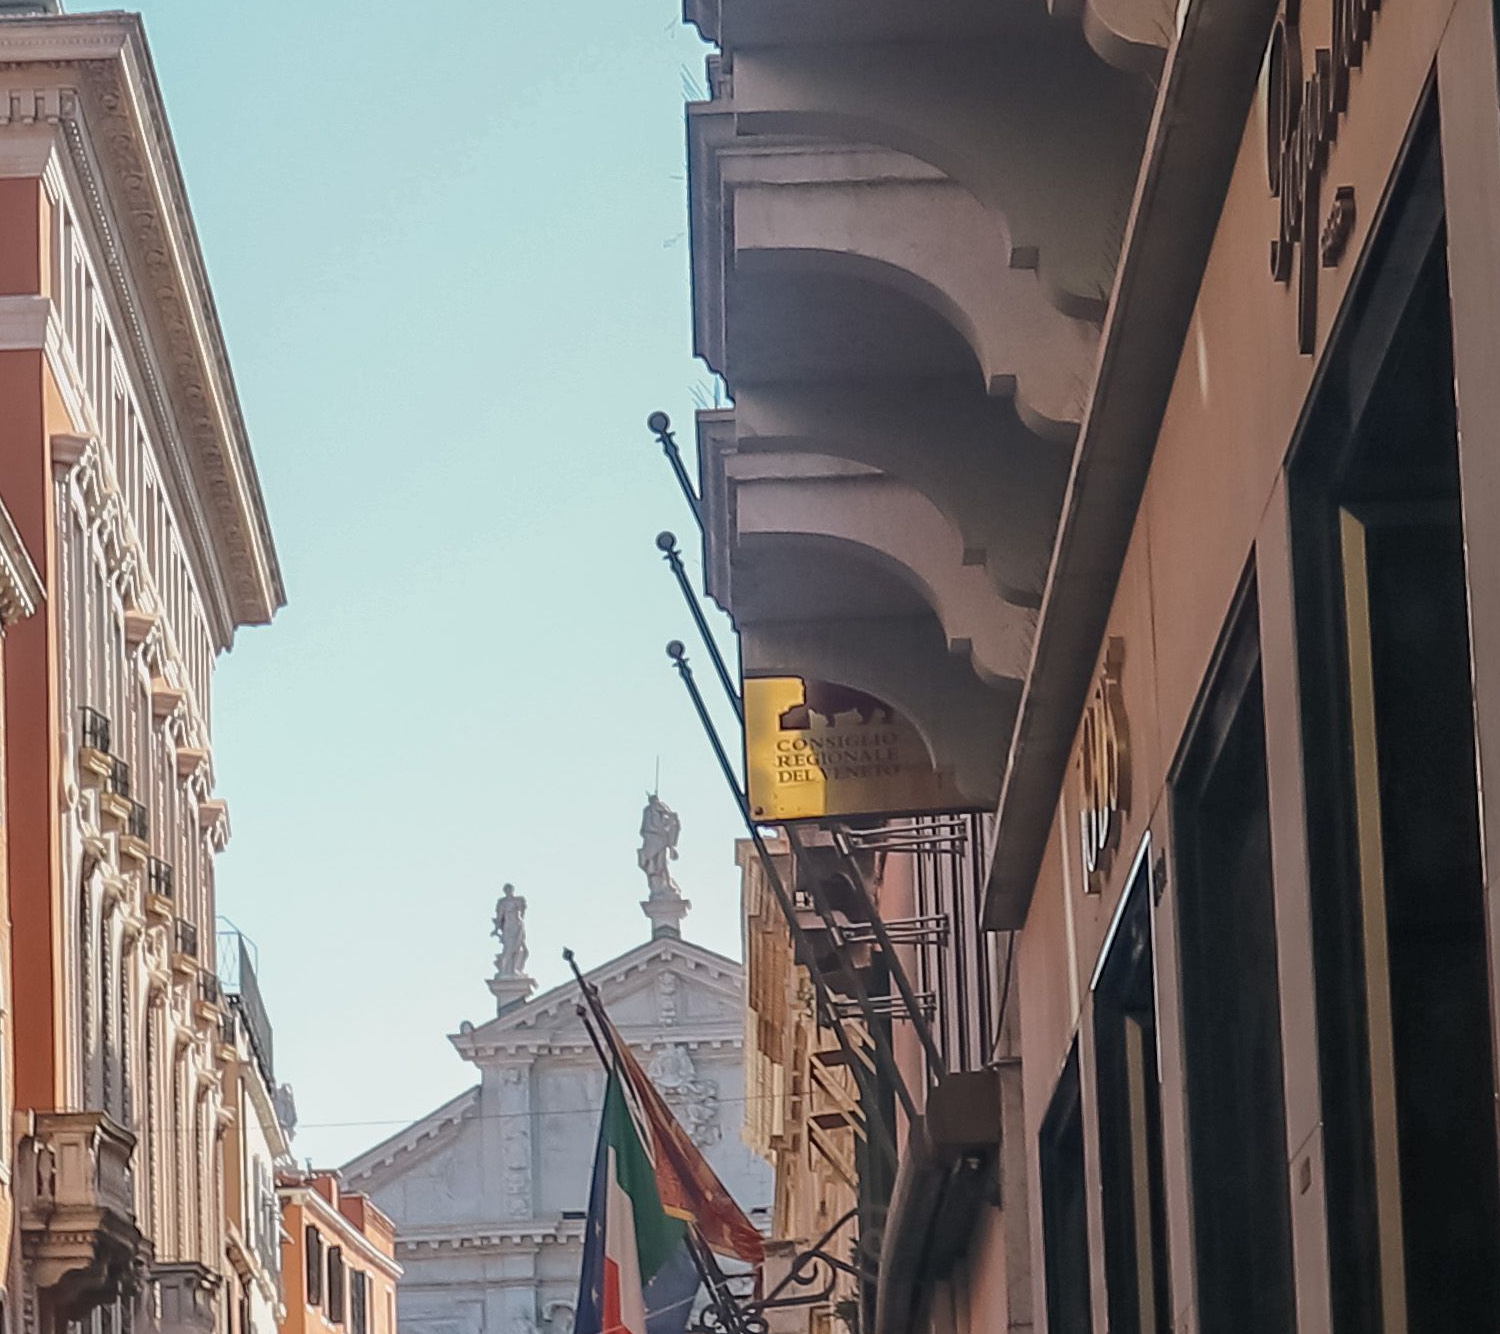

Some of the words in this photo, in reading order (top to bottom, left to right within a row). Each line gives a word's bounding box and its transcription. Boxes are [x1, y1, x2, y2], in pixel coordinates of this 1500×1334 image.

[777, 732, 897, 752] CONSIGLIO
[777, 748, 899, 767] REGIONALE
[778, 769, 816, 783] DEL
[822, 764, 900, 780] VENETO
